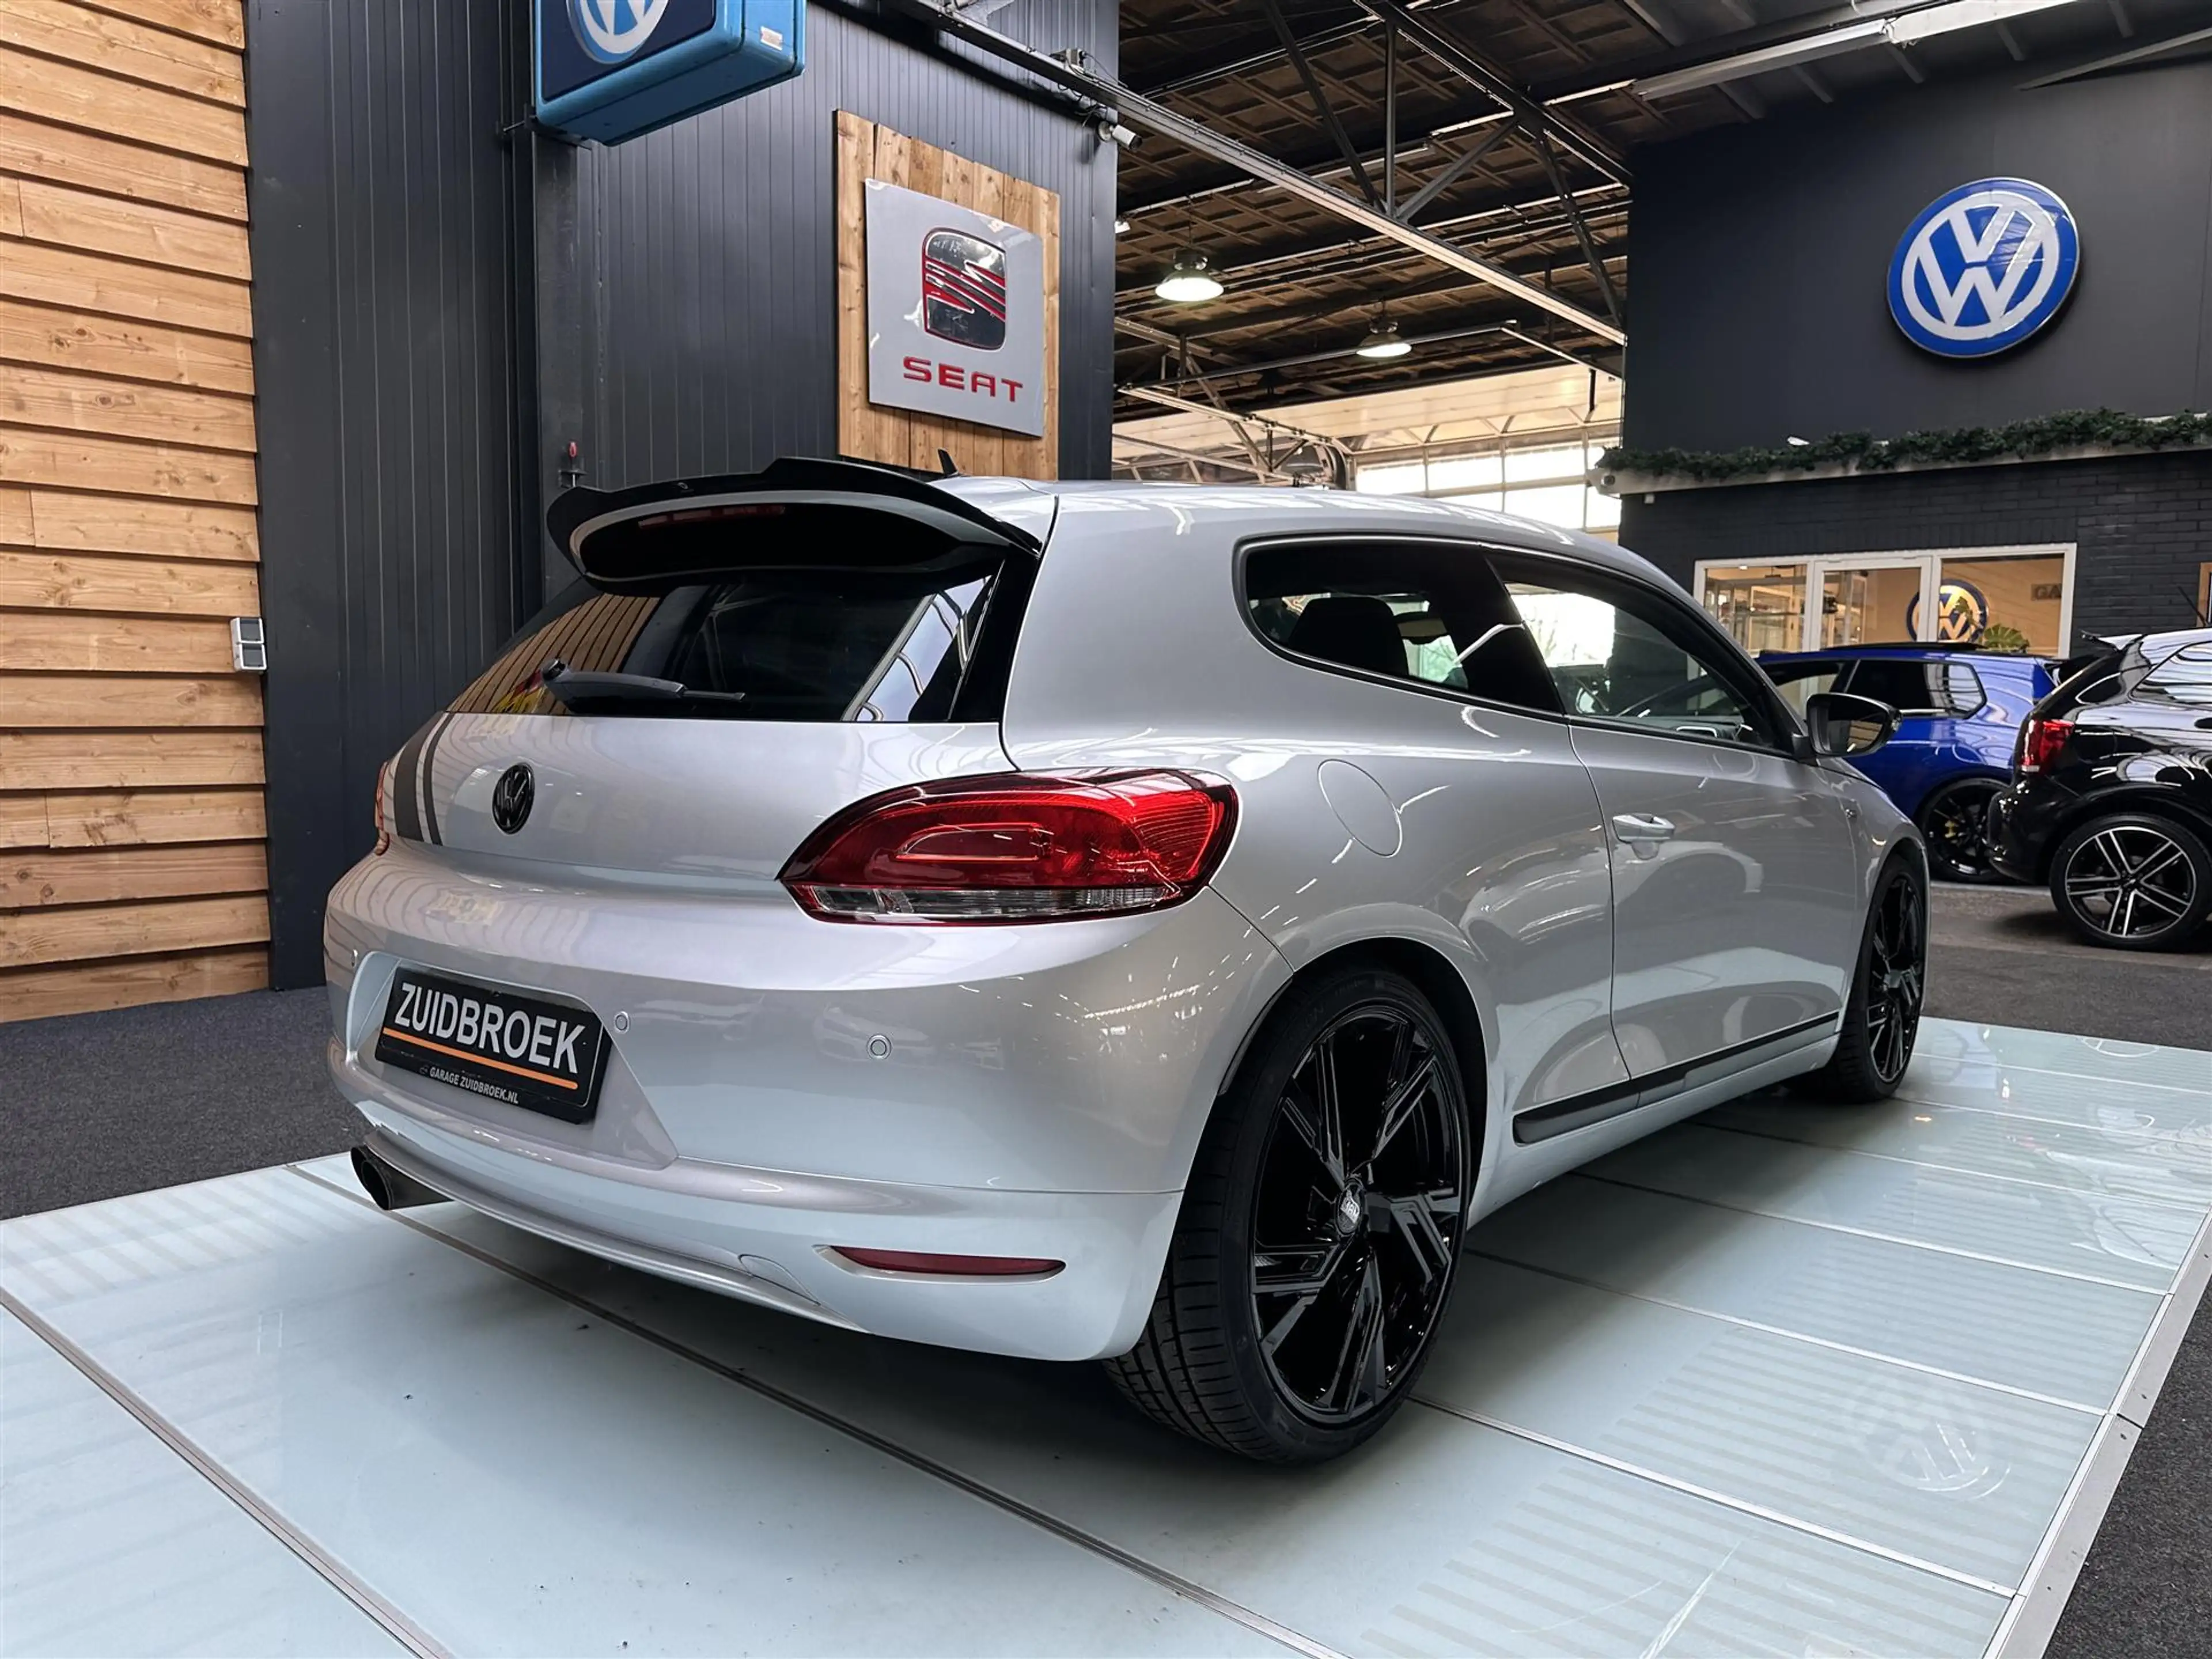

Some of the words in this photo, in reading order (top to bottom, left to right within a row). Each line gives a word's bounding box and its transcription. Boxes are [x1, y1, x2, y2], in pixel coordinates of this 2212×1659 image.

[1902, 190, 2060, 340] VW
[903, 356, 1023, 402] SEAT
[395, 983, 585, 1074] ZUIDBROEK
[430, 1067, 459, 1085] GARAGE
[460, 1076, 518, 1104] ZUIDBROEK.NL
